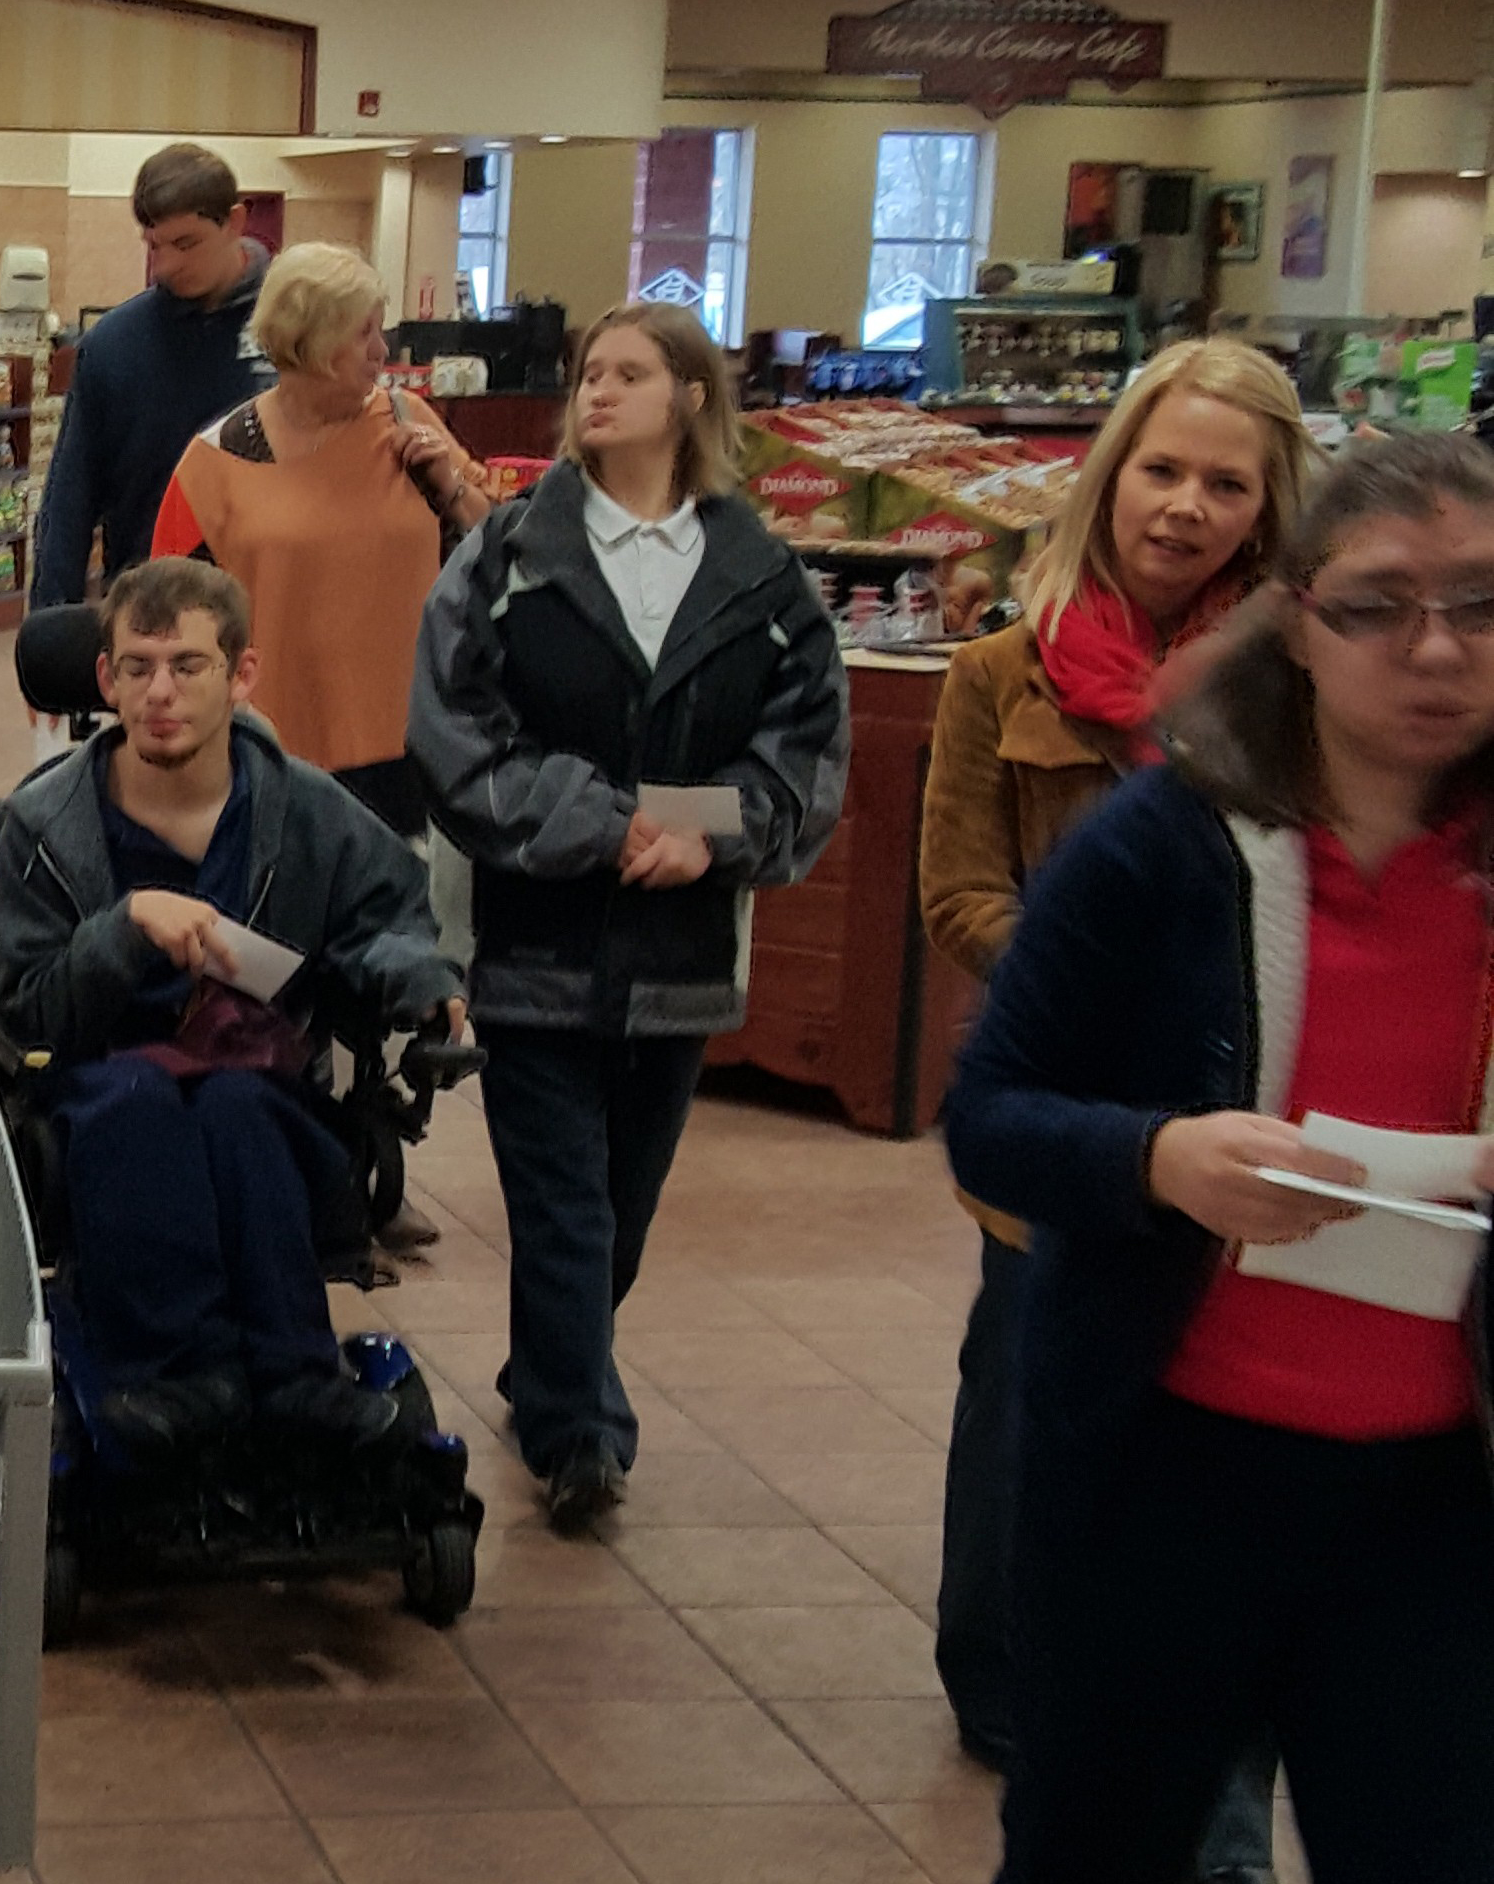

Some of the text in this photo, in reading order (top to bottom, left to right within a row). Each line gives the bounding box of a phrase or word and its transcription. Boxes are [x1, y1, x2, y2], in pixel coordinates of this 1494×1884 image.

[868, 24, 978, 58] Market
[975, 25, 1076, 62] Center
[760, 477, 839, 497] DIAMOND
